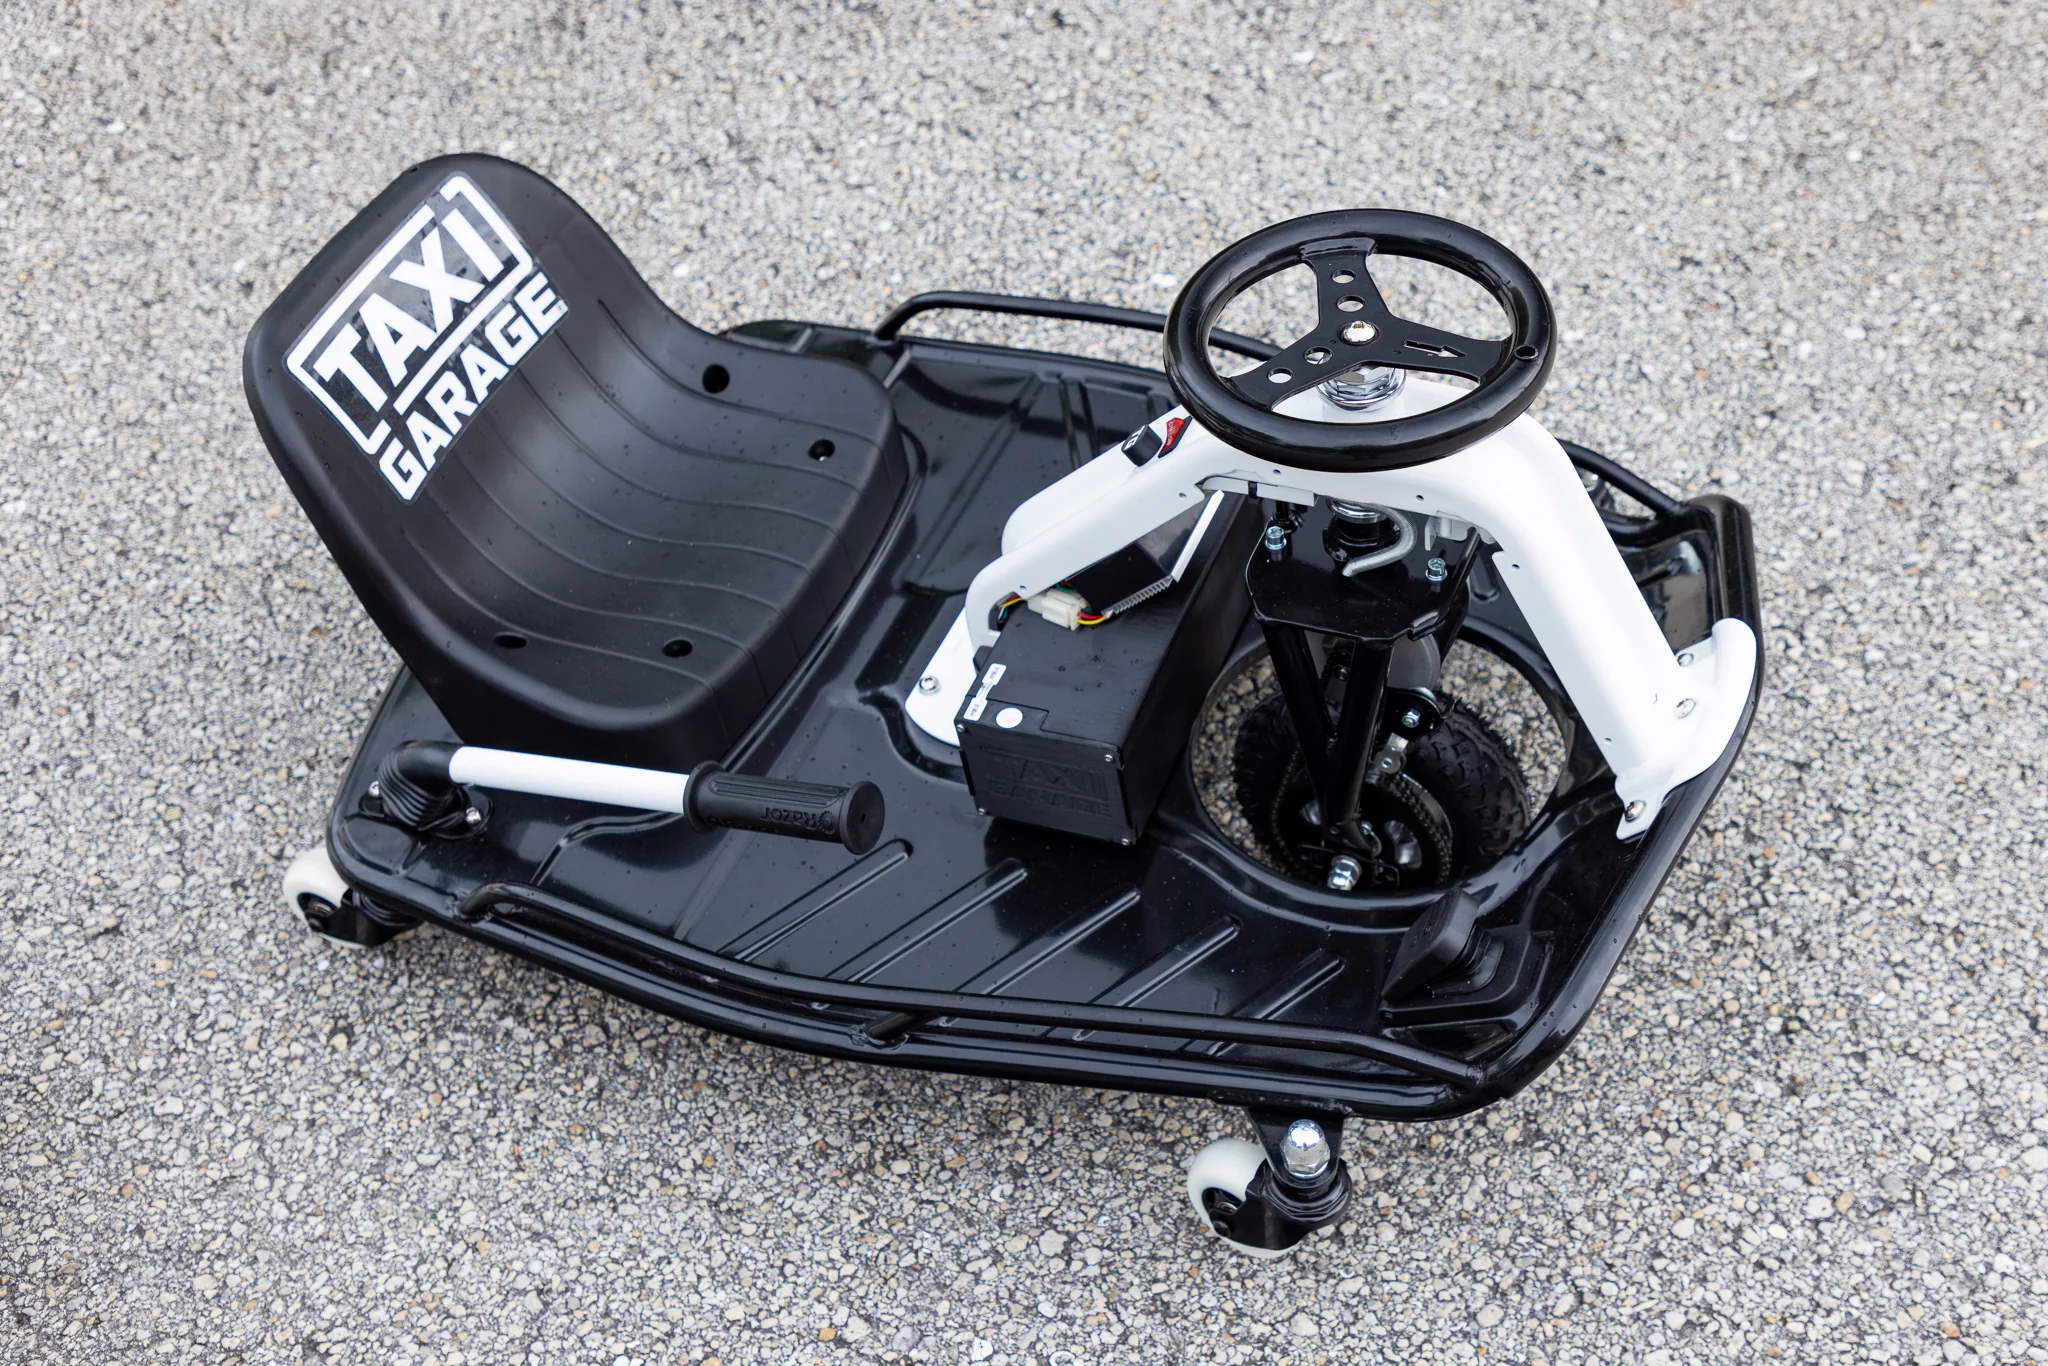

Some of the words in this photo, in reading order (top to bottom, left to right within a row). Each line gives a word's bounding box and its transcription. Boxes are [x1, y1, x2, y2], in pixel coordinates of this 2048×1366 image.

[312, 208, 505, 412] TAXI
[379, 271, 569, 500] GARAGE
[760, 807, 818, 831] Razor
